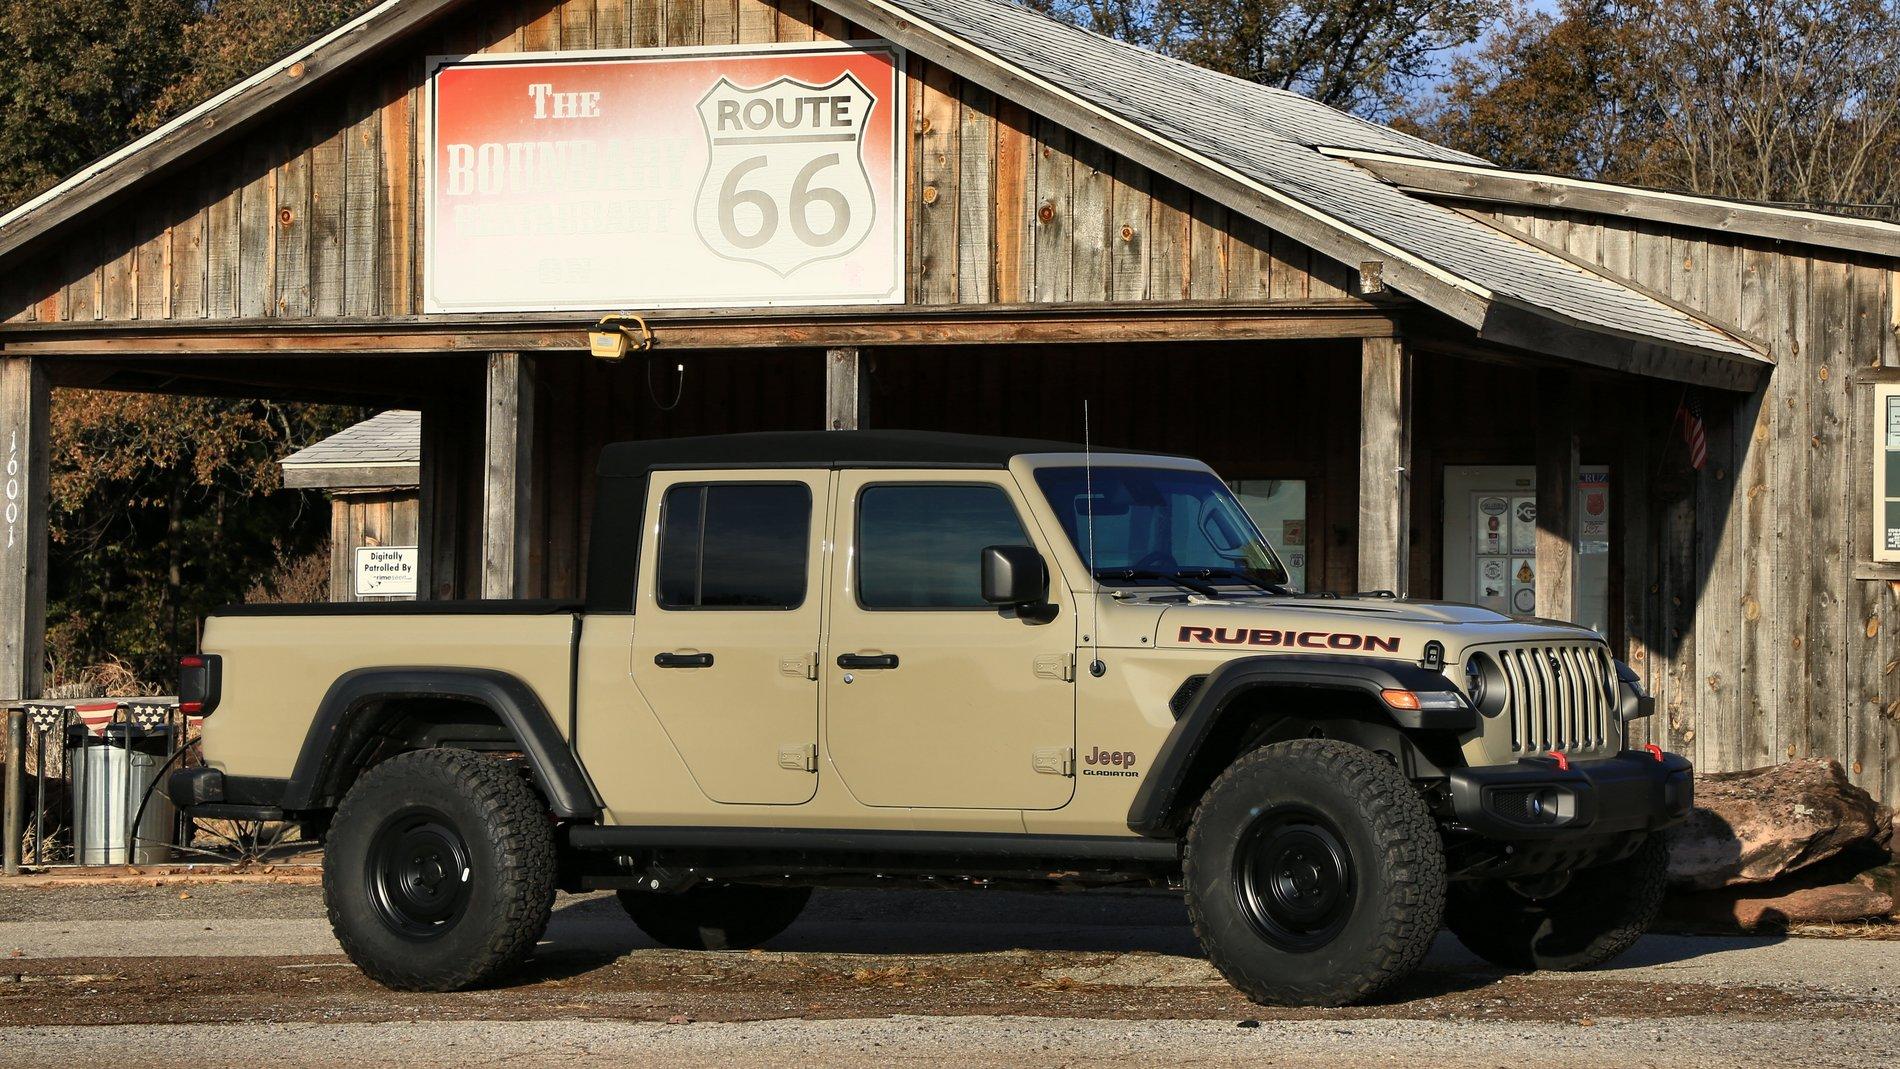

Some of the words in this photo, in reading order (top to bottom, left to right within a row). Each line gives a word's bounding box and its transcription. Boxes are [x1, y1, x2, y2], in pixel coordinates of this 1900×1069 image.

[717, 96, 853, 131] ROUTE
[717, 153, 852, 250] 66
[6, 430, 18, 549] 16001
[364, 563, 400, 572] Patrolled
[402, 563, 412, 573] By
[370, 551, 403, 562] Digitally
[1177, 625, 1402, 653] RUBICON
[1085, 746, 1136, 769] Jeep
[1083, 769, 1139, 777] GLADIATOR
